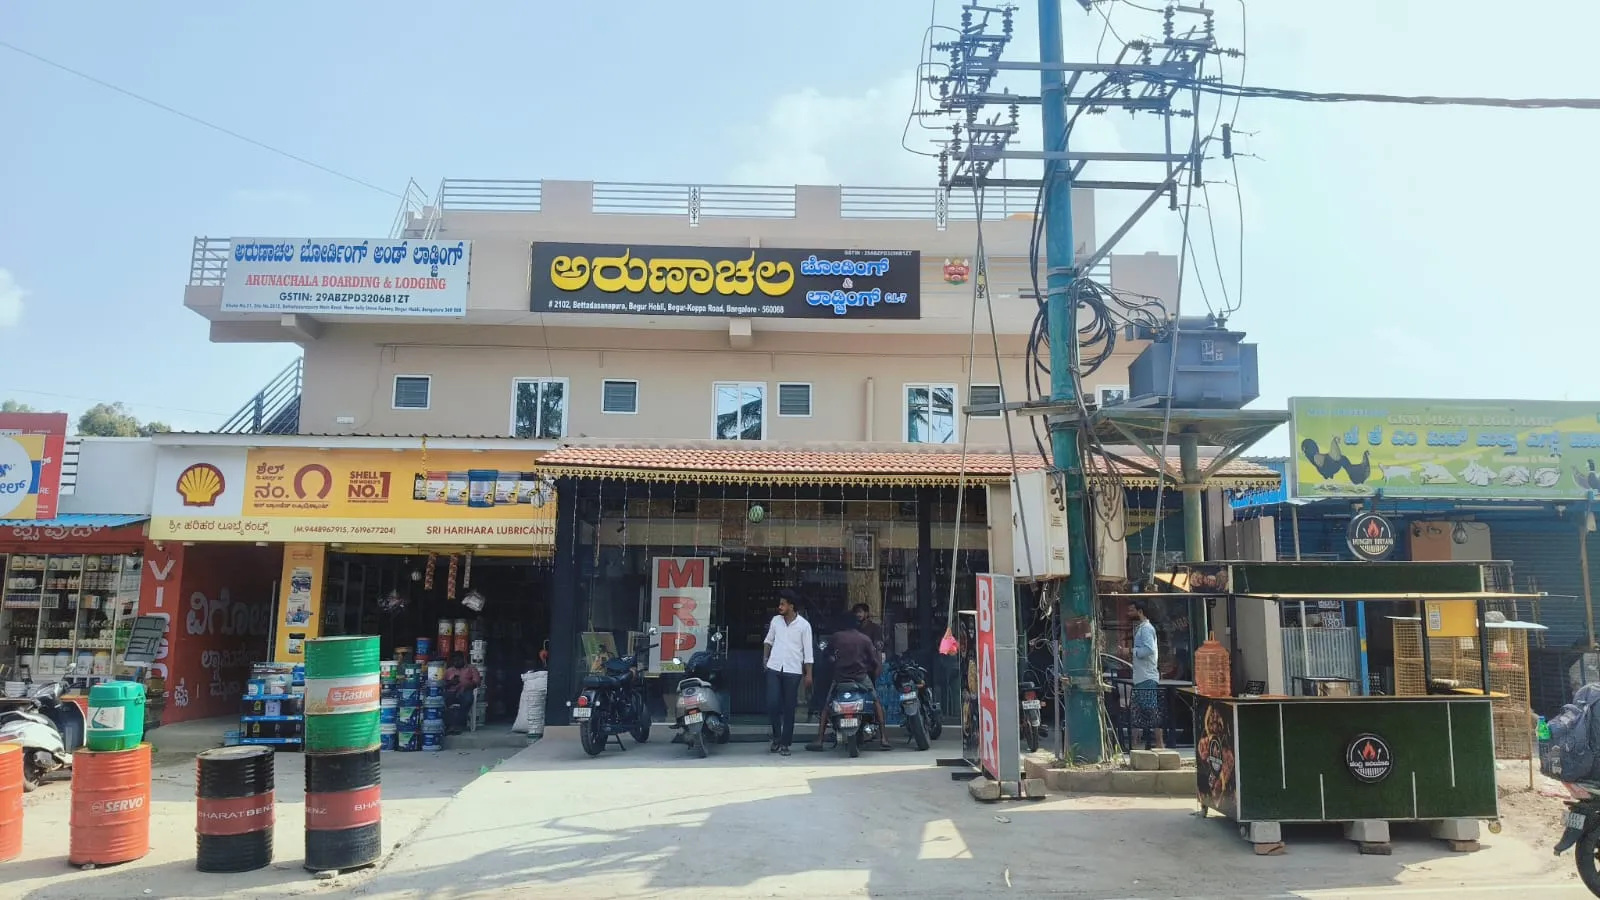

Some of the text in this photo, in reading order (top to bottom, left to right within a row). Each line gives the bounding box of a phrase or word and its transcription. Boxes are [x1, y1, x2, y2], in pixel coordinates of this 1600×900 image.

[235, 240, 294, 262] ಅರುಣಾಚಲ
[374, 241, 407, 264] ಅಂಡ್
[550, 248, 795, 297] ಅರುಣಾಚಲ
[245, 274, 446, 289] ARUNACHALA BOARDING & LODGING
[842, 277, 853, 288] &
[280, 292, 410, 304] GSTIN: 29ABZPD3206B1ZT
[548, 300, 553, 308] #
[554, 300, 571, 309] 2102,
[708, 304, 724, 314] Road,
[726, 305, 757, 315] Bangalore
[1424, 415, 1465, 427] MEAT
[1467, 416, 1480, 427] &
[1482, 416, 1511, 427] EGG
[1514, 416, 1553, 428] MART
[349, 471, 378, 480] SHELL
[184, 519, 216, 530] ಹರಿಹರ
[426, 526, 554, 535] SRI HARIHARA LUBRICANTS
[978, 579, 996, 770] BAR
[342, 689, 374, 701] Castrol
[104, 798, 144, 813] SERVO
